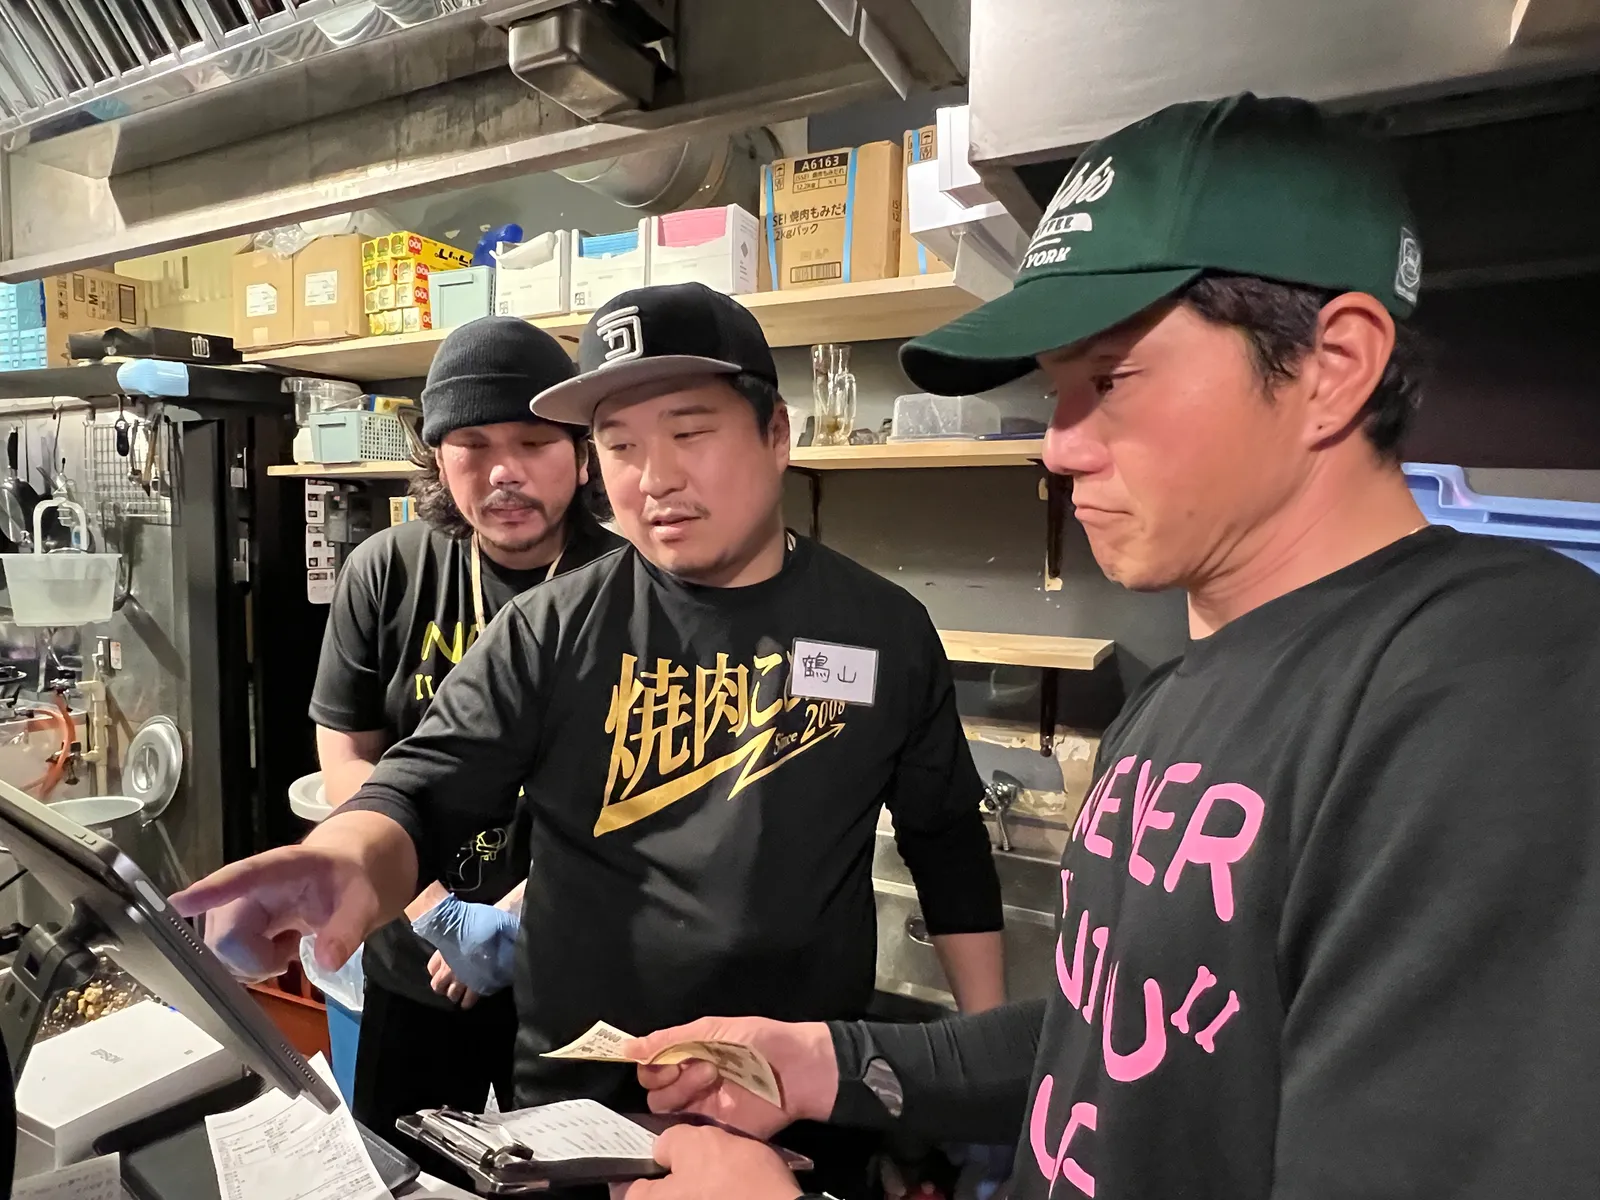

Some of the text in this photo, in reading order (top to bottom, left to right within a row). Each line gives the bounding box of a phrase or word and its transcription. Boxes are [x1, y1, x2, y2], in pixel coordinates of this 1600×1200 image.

[801, 155, 840, 172] A6163
[1025, 246, 1072, 268] YORK
[774, 732, 798, 756] Since
[1072, 754, 1265, 922] NEVER
